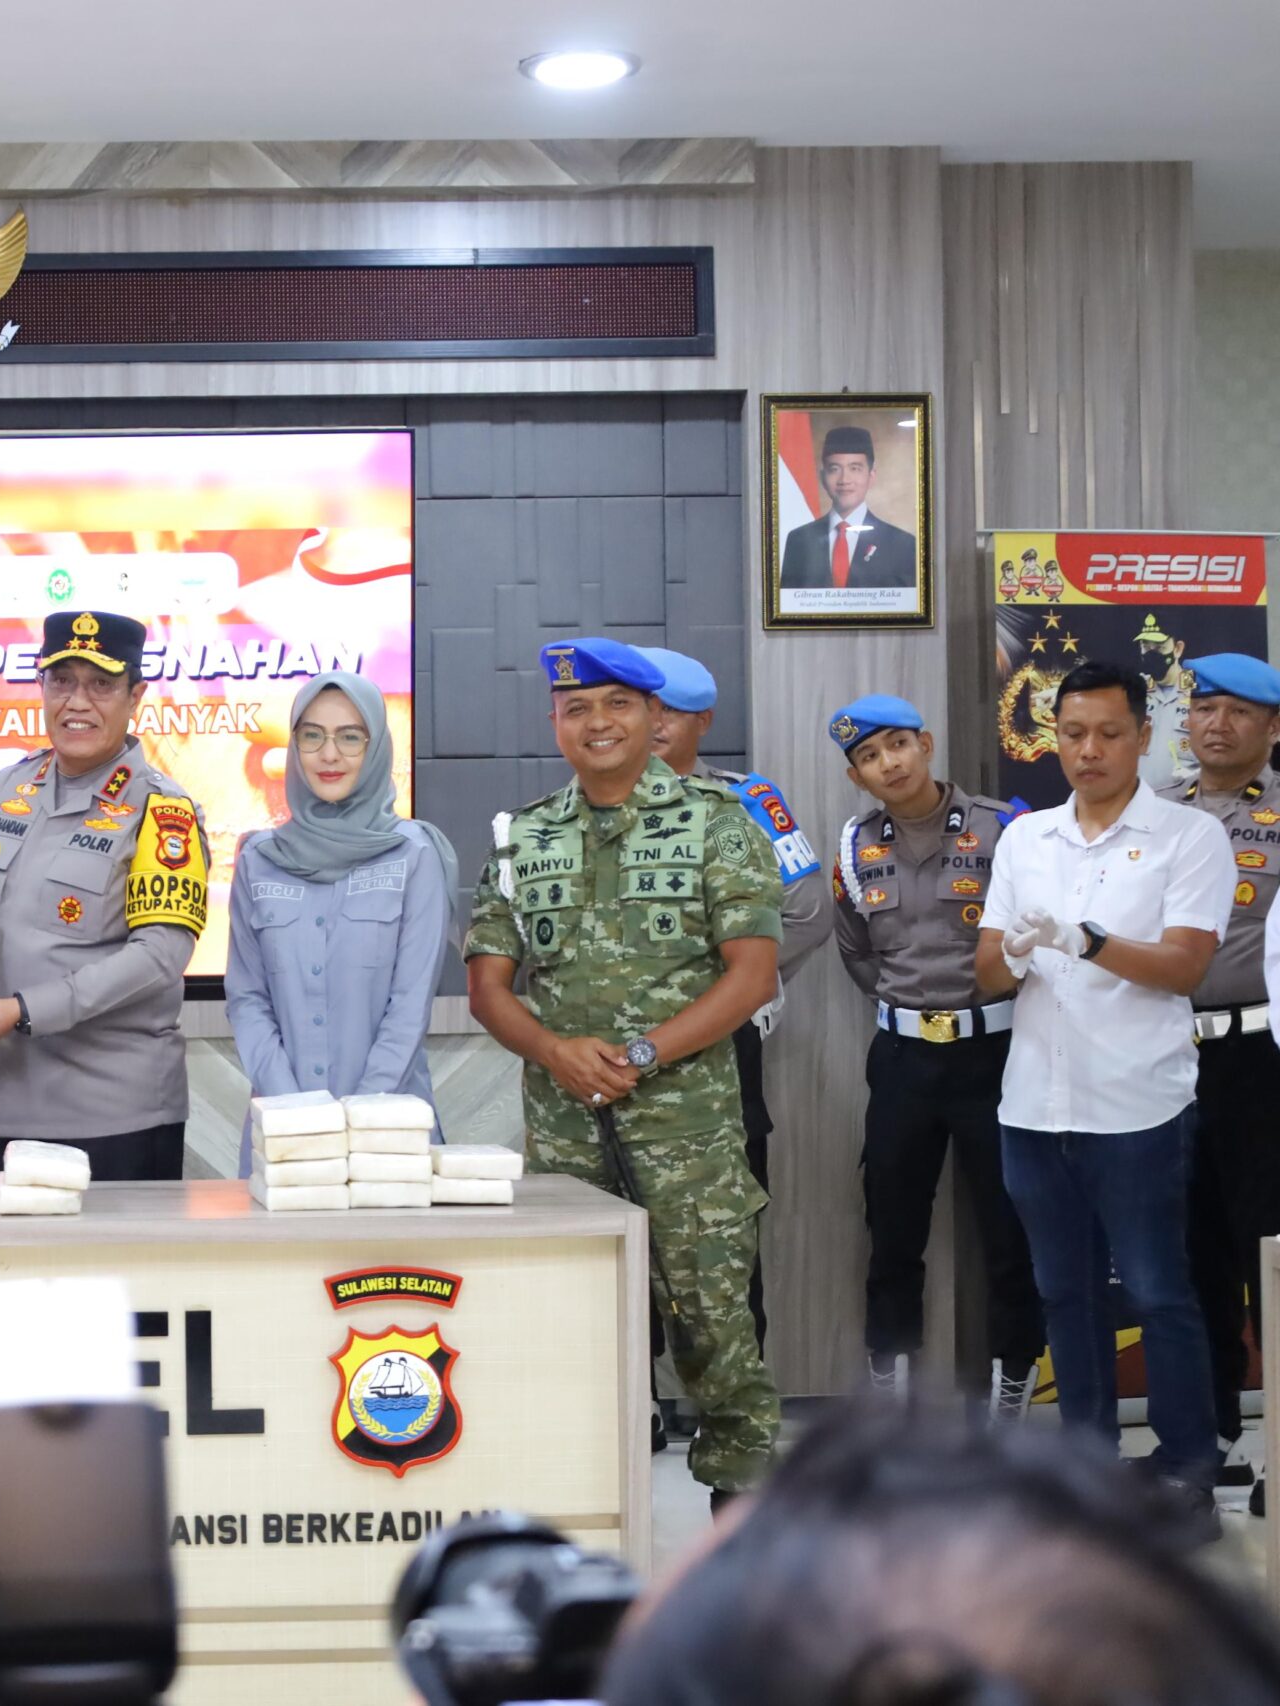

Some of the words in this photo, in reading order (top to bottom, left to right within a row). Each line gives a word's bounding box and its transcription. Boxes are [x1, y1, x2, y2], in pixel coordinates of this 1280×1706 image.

[1085, 553, 1247, 582] PRESISI
[155, 806, 193, 822] POLDA
[69, 833, 114, 854] POLRI
[631, 848, 662, 862] TNI
[670, 845, 697, 860] AL
[941, 856, 992, 869] POLRI
[516, 857, 574, 879] WAHYU
[257, 885, 295, 897] CICU
[358, 876, 394, 889] KETUA
[337, 1277, 397, 1298] SULAWESI
[399, 1276, 453, 1296] SELATAN
[262, 1509, 503, 1545] BERKEADI
